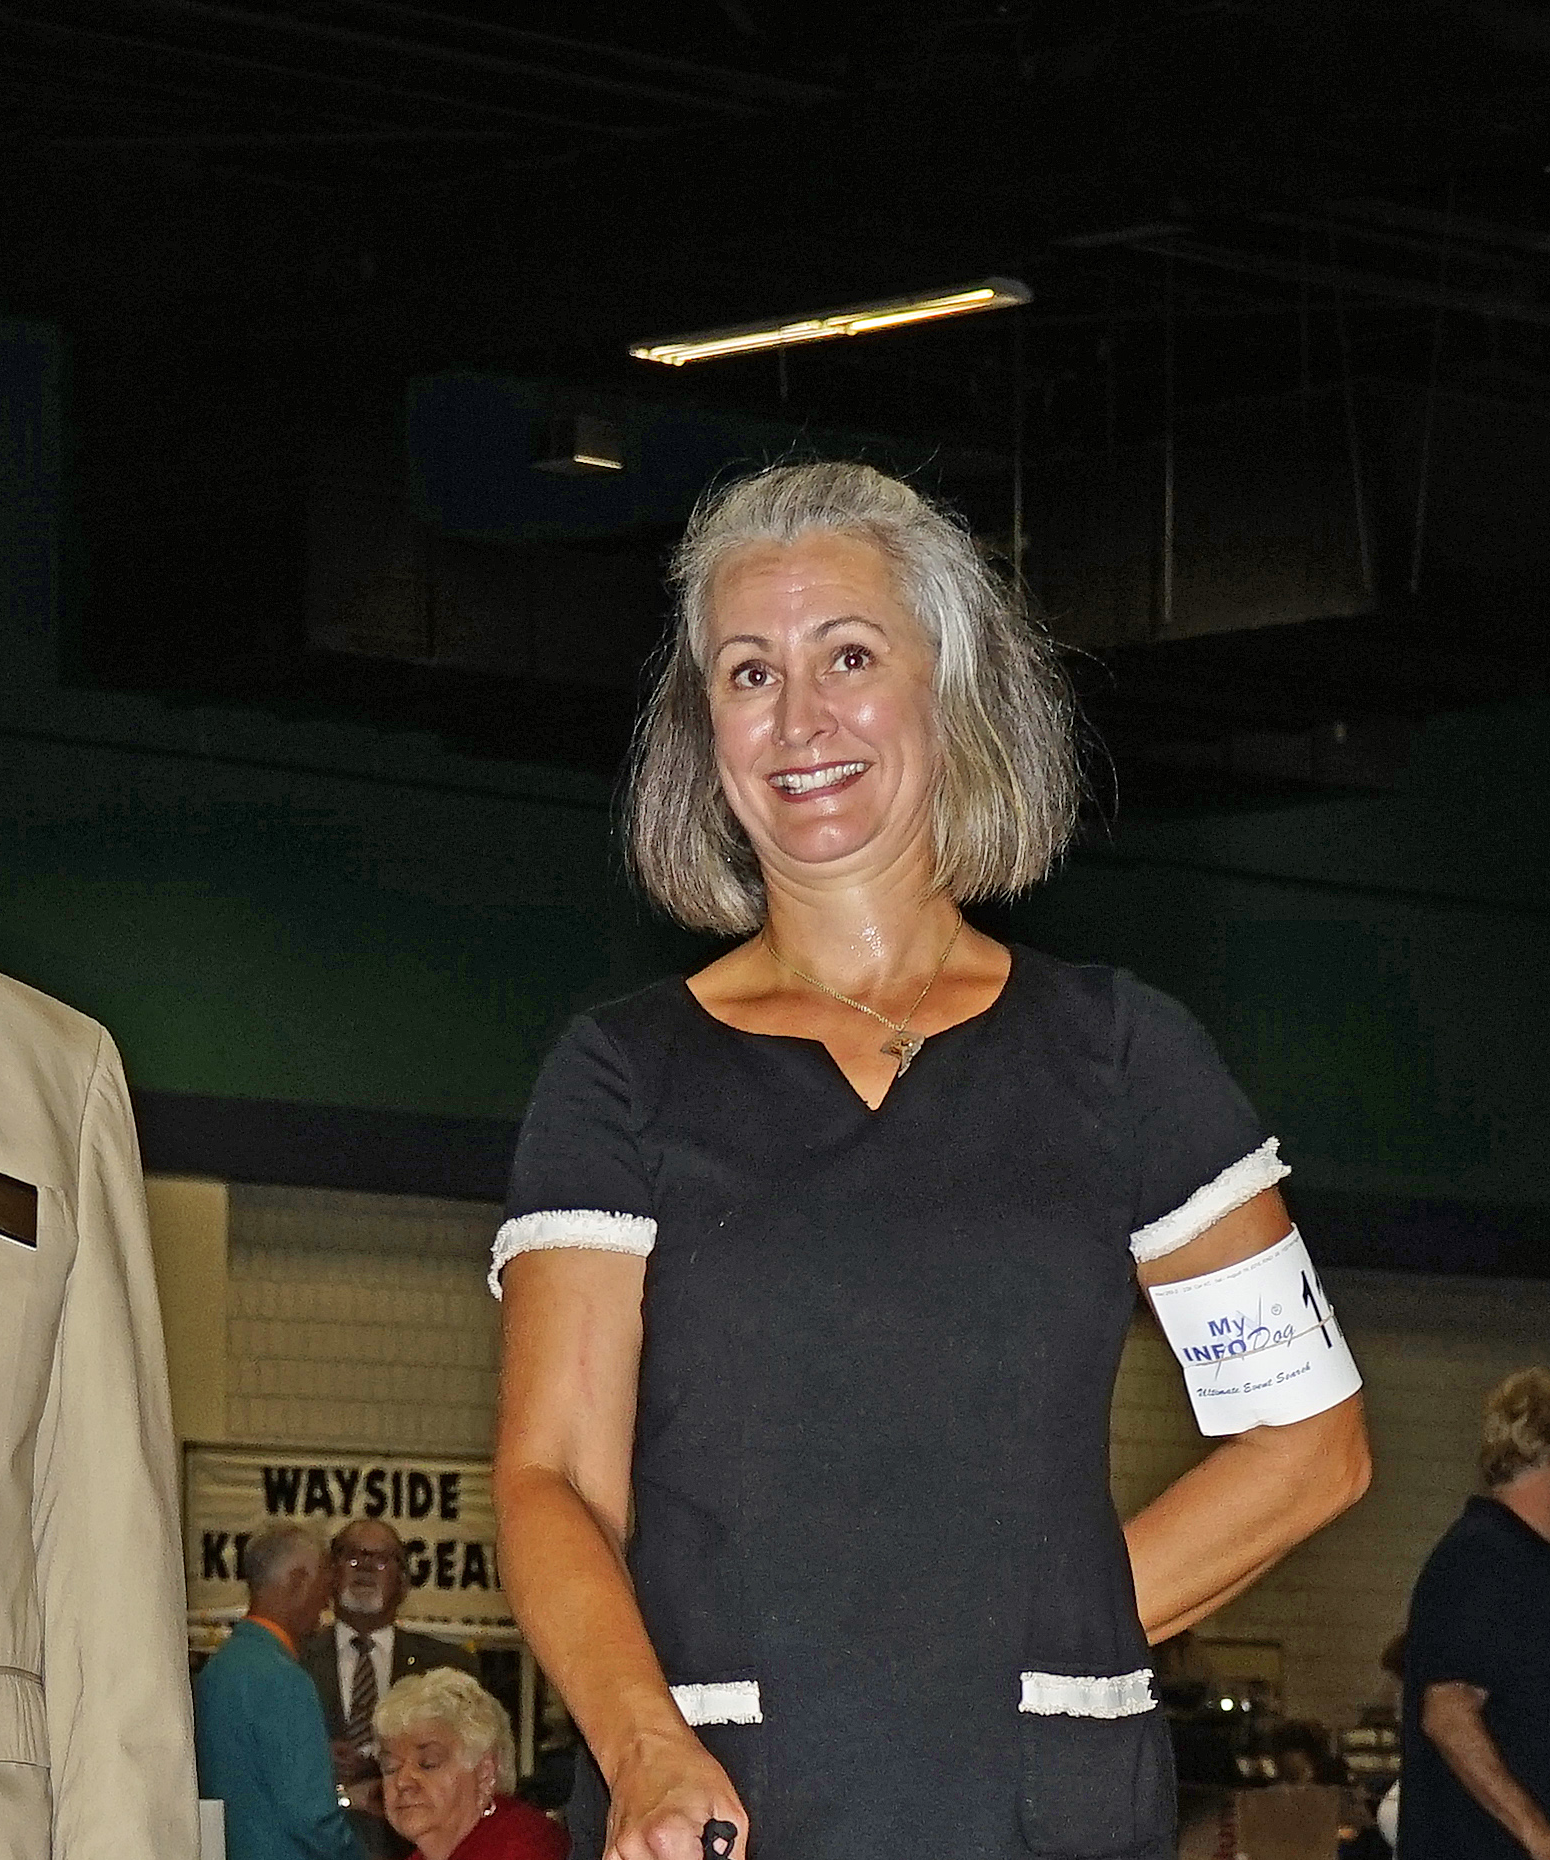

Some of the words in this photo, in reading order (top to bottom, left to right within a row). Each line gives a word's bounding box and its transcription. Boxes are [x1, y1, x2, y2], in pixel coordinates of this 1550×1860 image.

[1182, 1338, 1246, 1361] INFO
[1247, 1323, 1294, 1351] Dog
[1207, 1316, 1245, 1337] My
[261, 1466, 460, 1521] WAYSIDE
[407, 1537, 503, 1590] GEA
